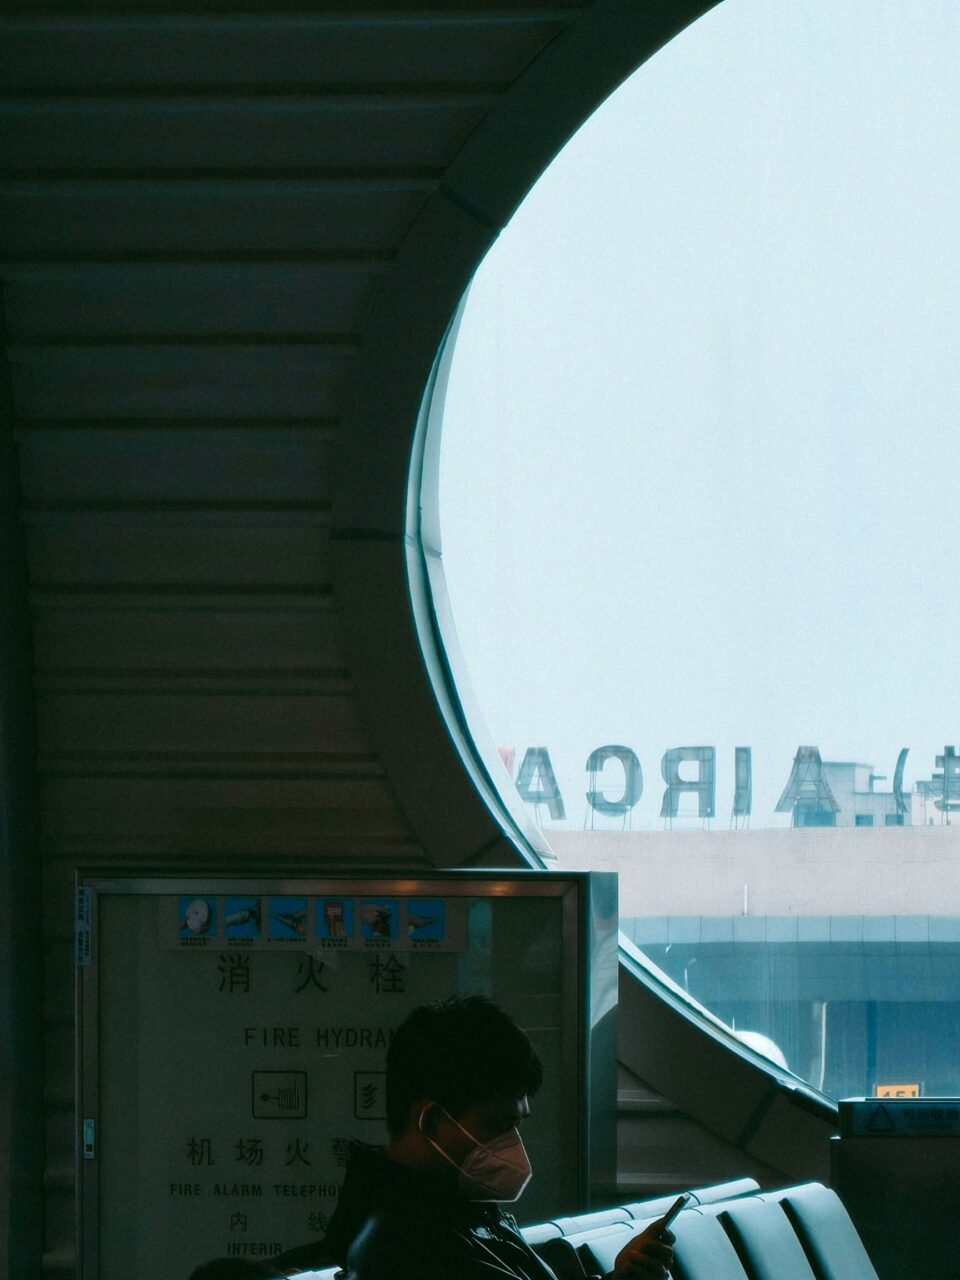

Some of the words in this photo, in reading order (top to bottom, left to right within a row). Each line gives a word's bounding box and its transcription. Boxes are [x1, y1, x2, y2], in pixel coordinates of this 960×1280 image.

[218, 953, 406, 994] 消火栓
[244, 1027, 300, 1048] FIRE
[170, 1183, 202, 1197] FIRE
[212, 1183, 263, 1197] ALARM
[229, 1211, 329, 1233] 内线
